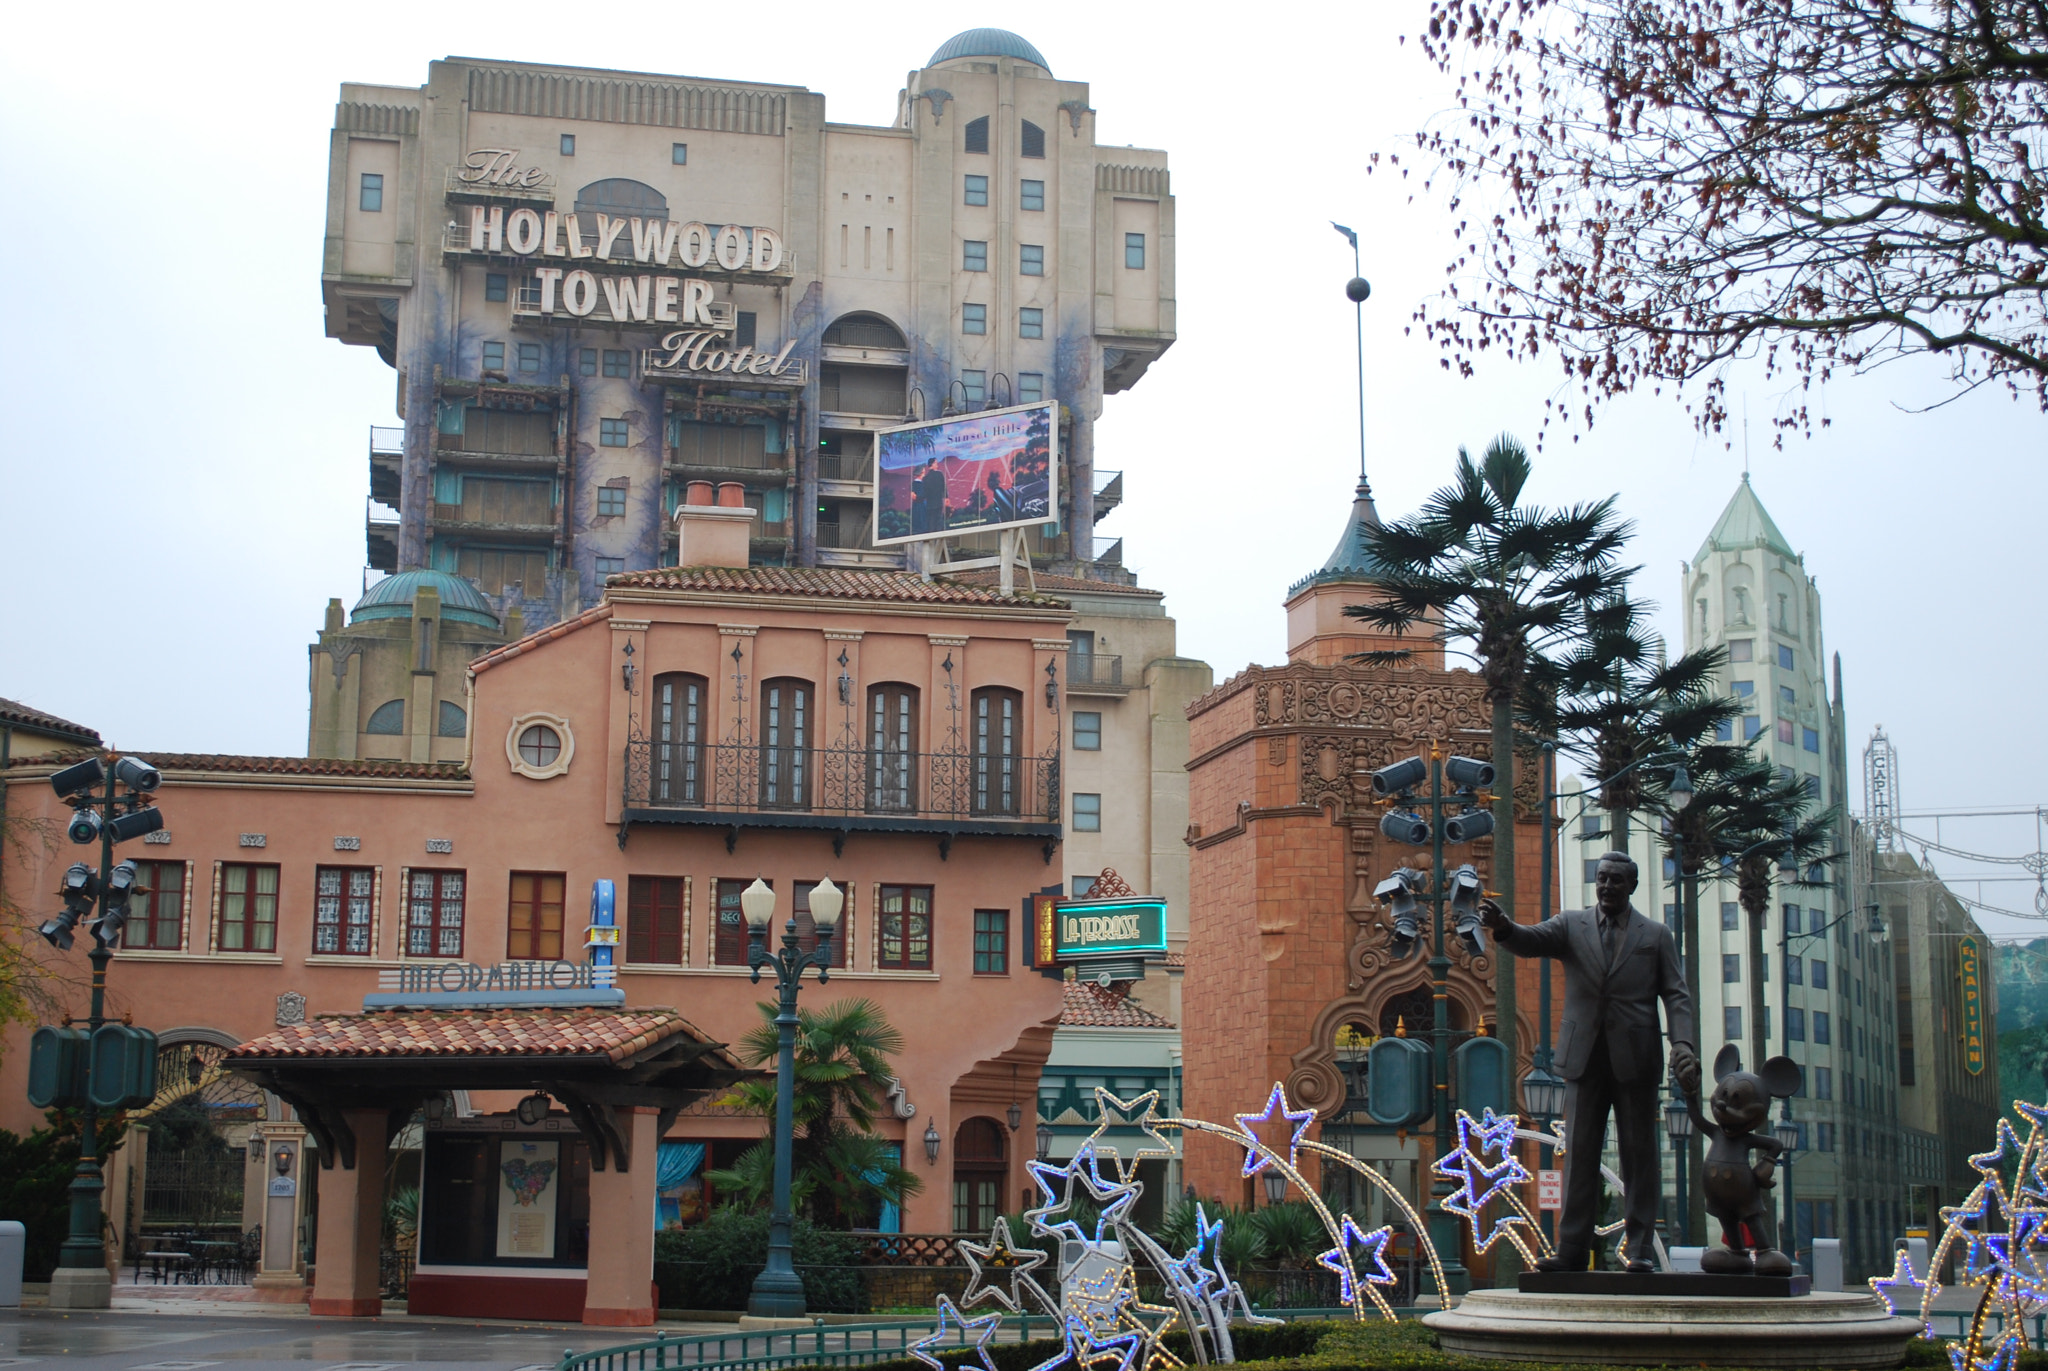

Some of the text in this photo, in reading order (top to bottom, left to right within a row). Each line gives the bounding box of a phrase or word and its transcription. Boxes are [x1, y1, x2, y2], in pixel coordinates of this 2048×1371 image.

[457, 148, 551, 188] The
[470, 205, 784, 273] HOLLYWOOD
[535, 267, 715, 326] TOWER
[653, 330, 799, 377] Hotel
[946, 422, 1021, 445] Sunset Hills
[1062, 914, 1140, 945] LA TERRASSE
[1962, 946, 1976, 959] EL
[400, 959, 594, 994] INFORMATION
[1963, 960, 1981, 1063] CAPITAN
